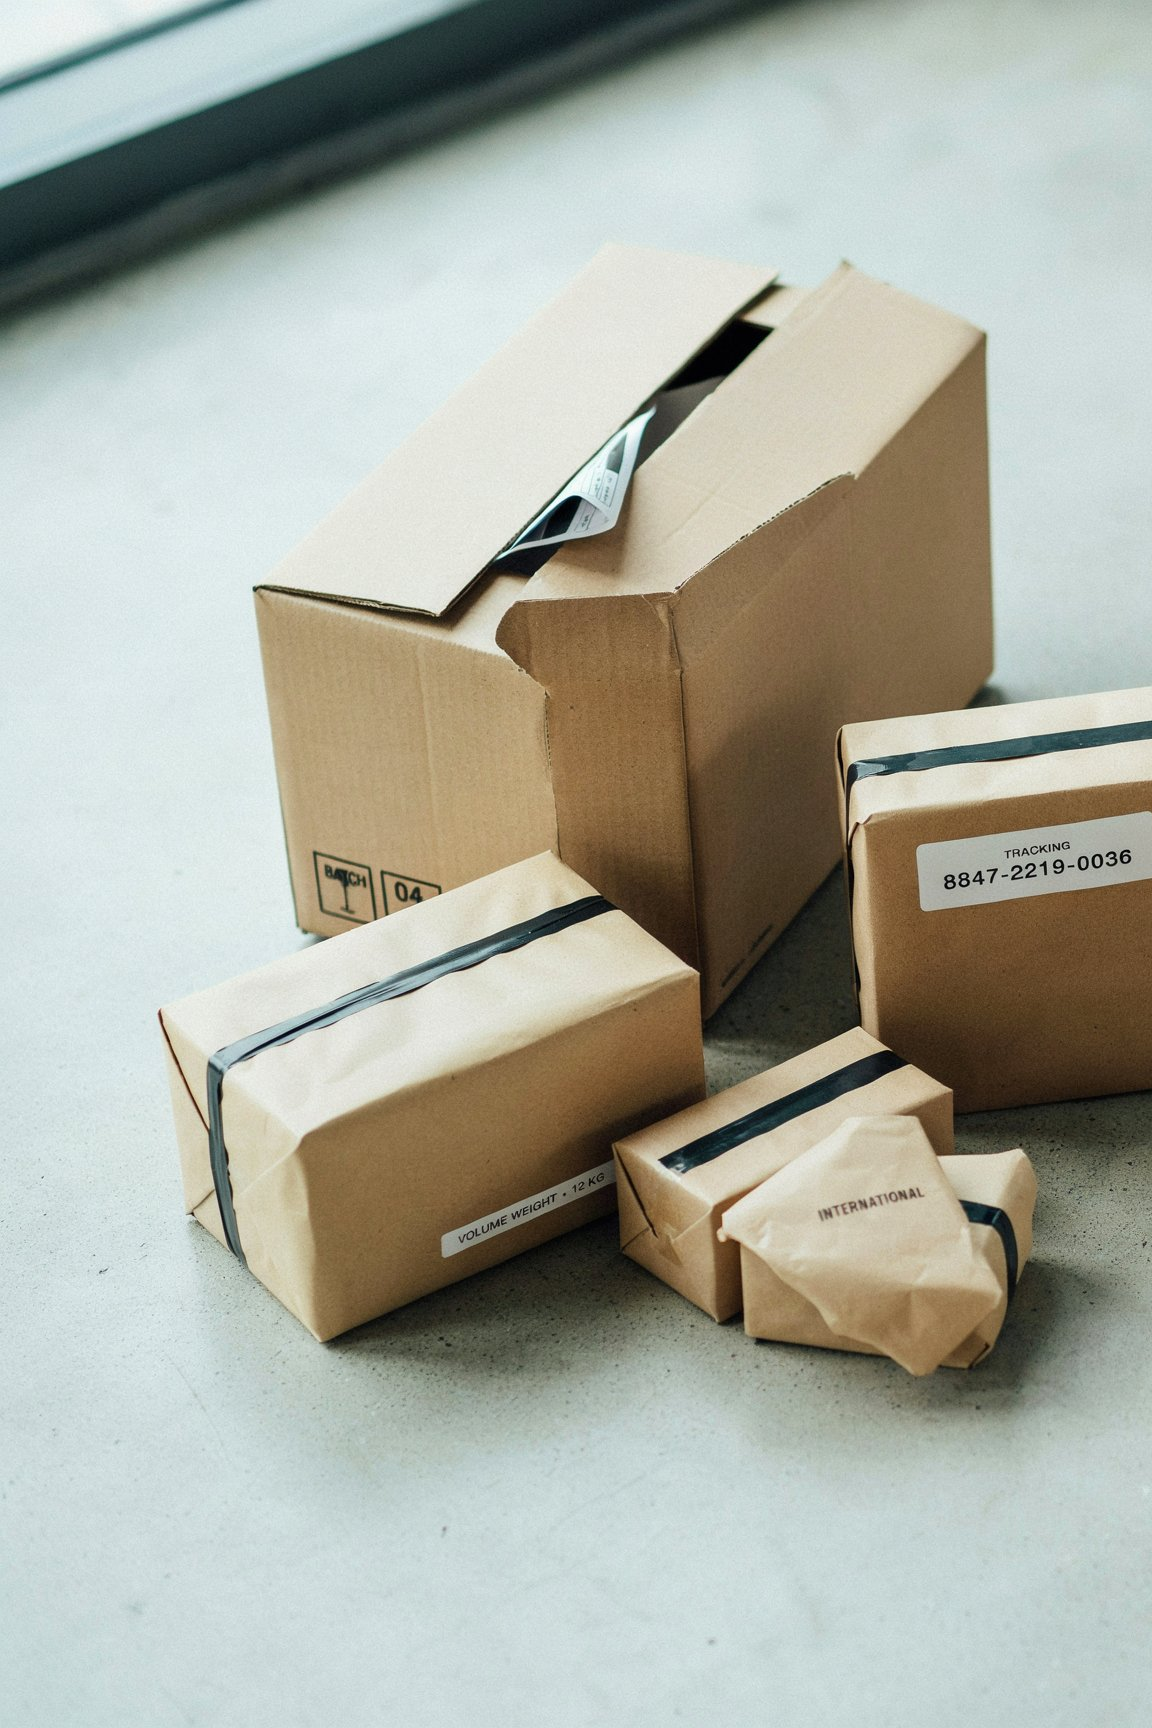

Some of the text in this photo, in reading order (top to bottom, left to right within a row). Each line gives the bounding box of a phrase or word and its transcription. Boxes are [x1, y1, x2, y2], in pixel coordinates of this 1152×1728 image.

[1004, 841, 1071, 859] TRACKING
[943, 849, 1132, 889] 8847-2219-0036
[394, 881, 423, 903] 04
[458, 1215, 507, 1244] VOLUME
[511, 1193, 557, 1221] WEIGHT
[571, 1181, 585, 1193] 12
[588, 1172, 605, 1187] KG
[817, 1187, 925, 1222] INTERNATIONAL
